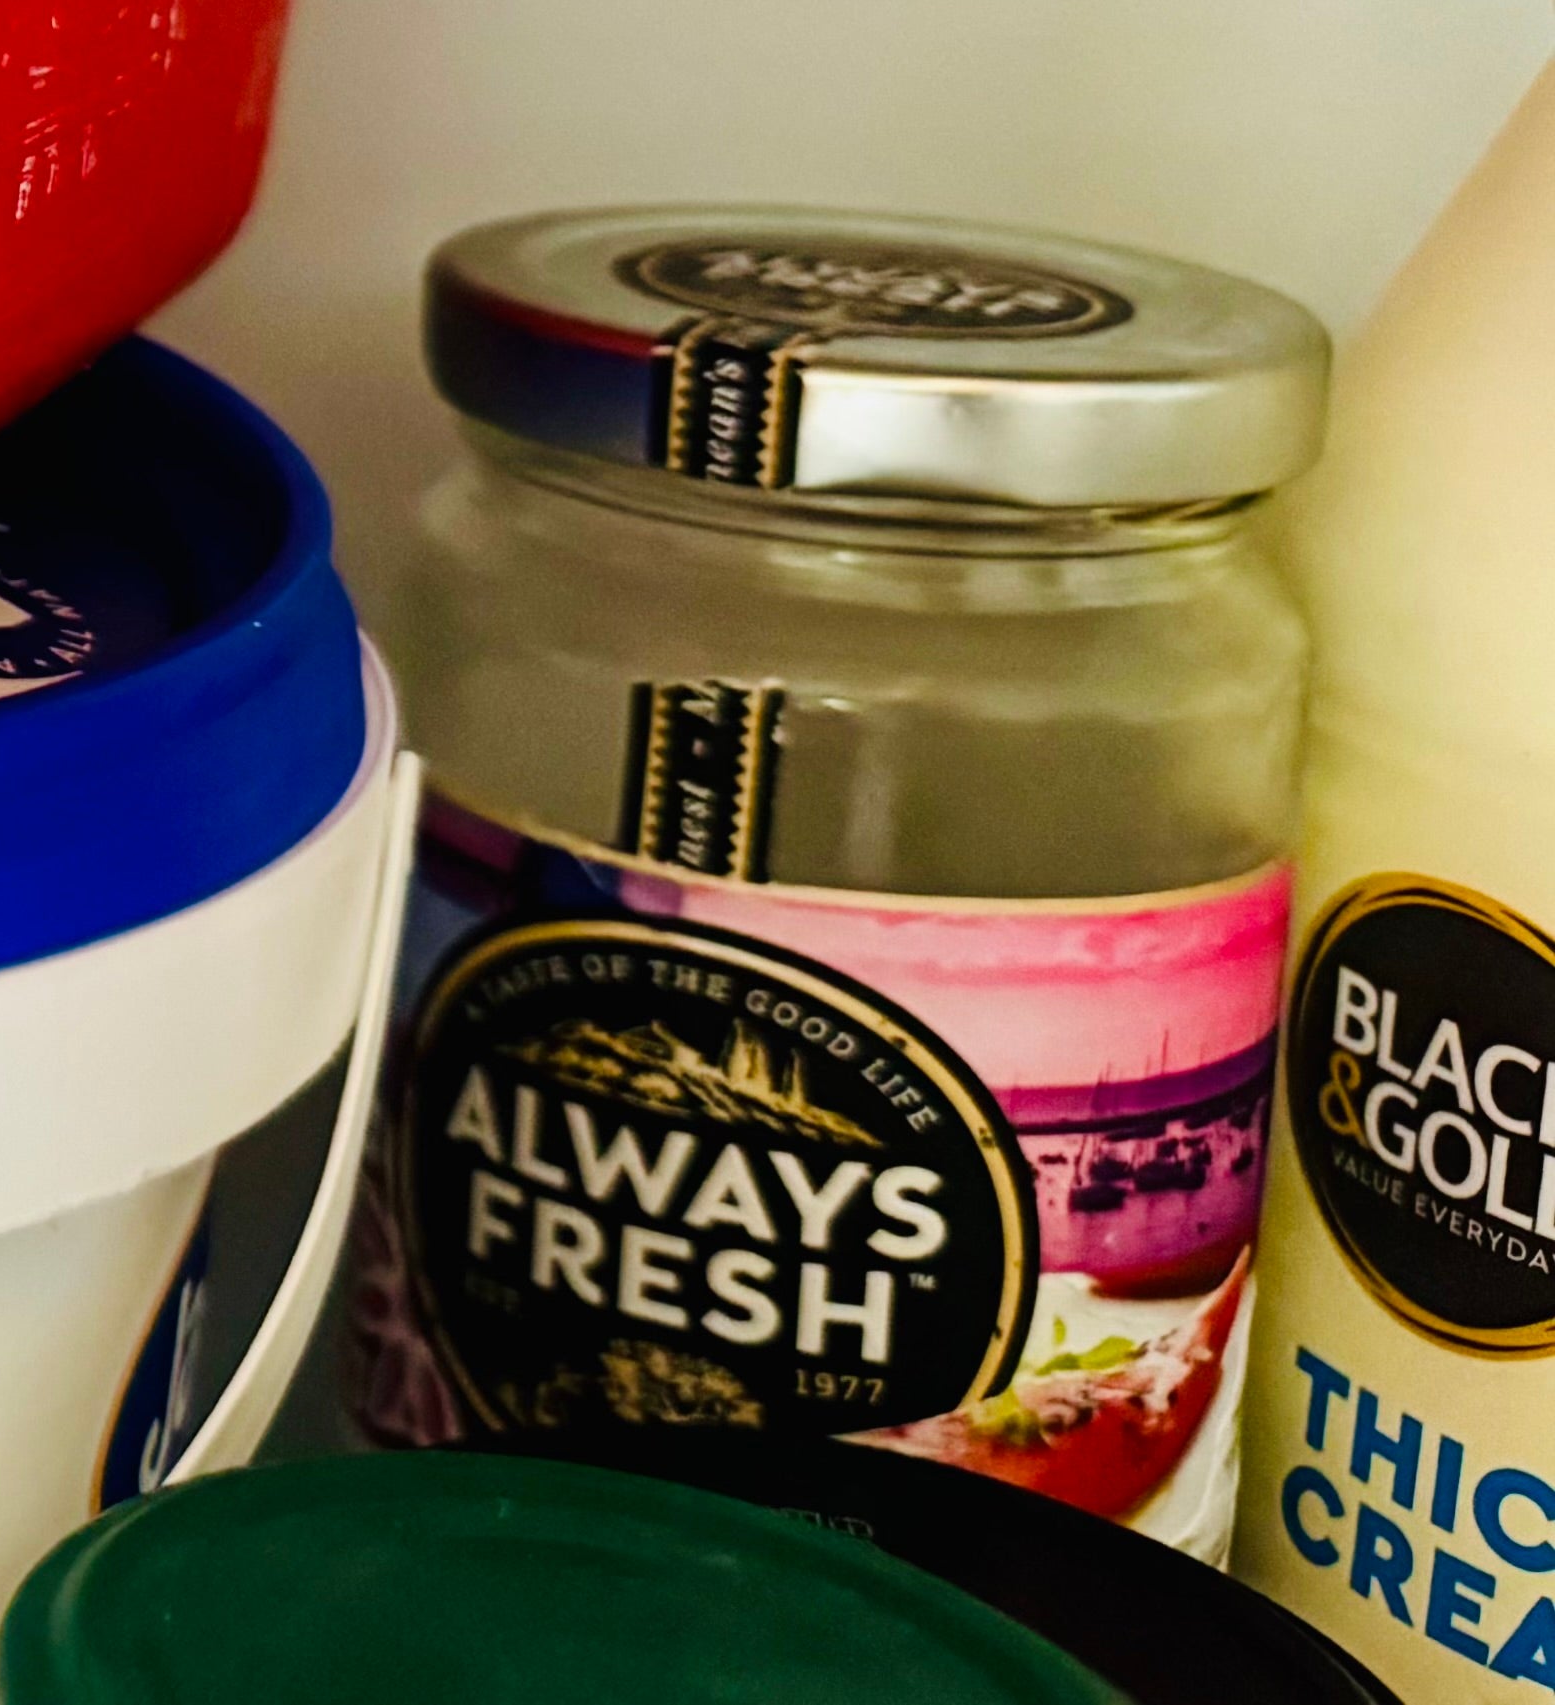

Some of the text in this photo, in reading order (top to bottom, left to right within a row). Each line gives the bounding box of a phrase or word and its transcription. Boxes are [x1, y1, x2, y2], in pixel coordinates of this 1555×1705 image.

[580, 952, 636, 983] OF
[646, 957, 736, 1002] THE
[744, 988, 859, 1059] GOOD
[859, 1057, 942, 1135] LIFE
[444, 1063, 950, 1263] ALWAYS
[1331, 1147, 1406, 1206] VALUE
[467, 1168, 895, 1366] FRESH
[794, 1368, 885, 1407] 1977
